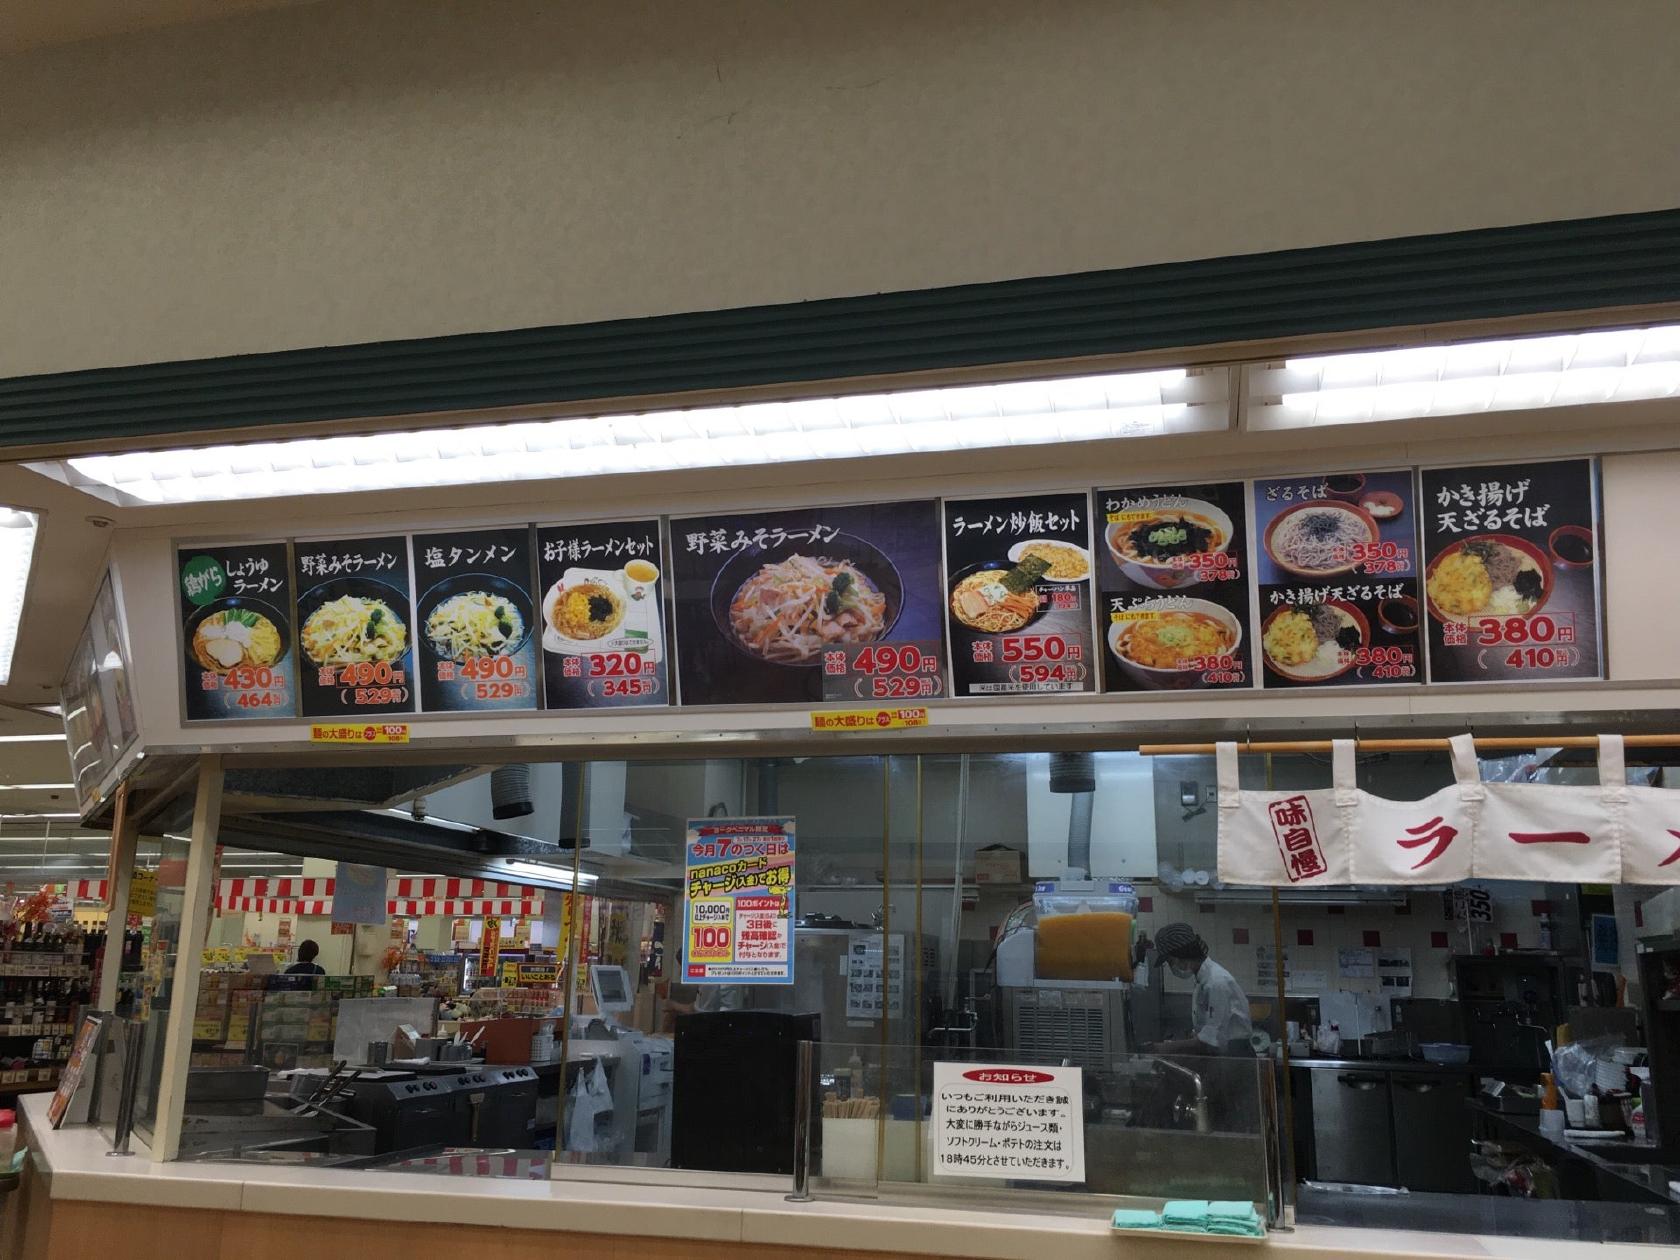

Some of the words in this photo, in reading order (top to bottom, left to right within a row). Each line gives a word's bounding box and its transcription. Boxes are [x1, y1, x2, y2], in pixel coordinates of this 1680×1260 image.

[1105, 494, 1187, 512] わかめうどん
[1266, 482, 1328, 501] ざるそば
[1436, 479, 1531, 507] かき揚げ
[953, 509, 1080, 536] ラーメン炒飯セット
[1436, 504, 1550, 533] 天ざるそば
[544, 536, 653, 562] お子様ラーメンセット
[686, 524, 840, 555] 野菜みそラーメン
[226, 558, 269, 577] しょうゆ
[300, 552, 397, 576] 野菜みそラーメン
[425, 545, 517, 568] 塩タンメン
[234, 577, 283, 595] ラーメン
[1270, 583, 1404, 604] かき揚げ天ざるそば
[1110, 594, 1193, 612] 天ぷらうどん
[1477, 616, 1574, 646] 380円
[853, 645, 937, 675] 490円
[1001, 635, 1081, 662] 550円
[339, 661, 405, 687] 490円
[460, 655, 527, 681] 490円
[589, 651, 655, 677] 320円
[223, 665, 286, 691] 430円
[693, 837, 790, 858] 今月7のつく日は
[1275, 801, 1321, 876] 味自慢
[690, 857, 768, 880] nanacoカード
[693, 926, 731, 949] 100
[978, 1072, 1037, 1083] お知らせ
[941, 1092, 1069, 1105] いつもご利用いただき誠
[946, 1106, 1066, 1118] にありがとうございます。
[947, 1137, 1061, 1151] ソフトクリーム・ポテトの注文は
[941, 1154, 1069, 1170] 18時45分とさせていただきます。
